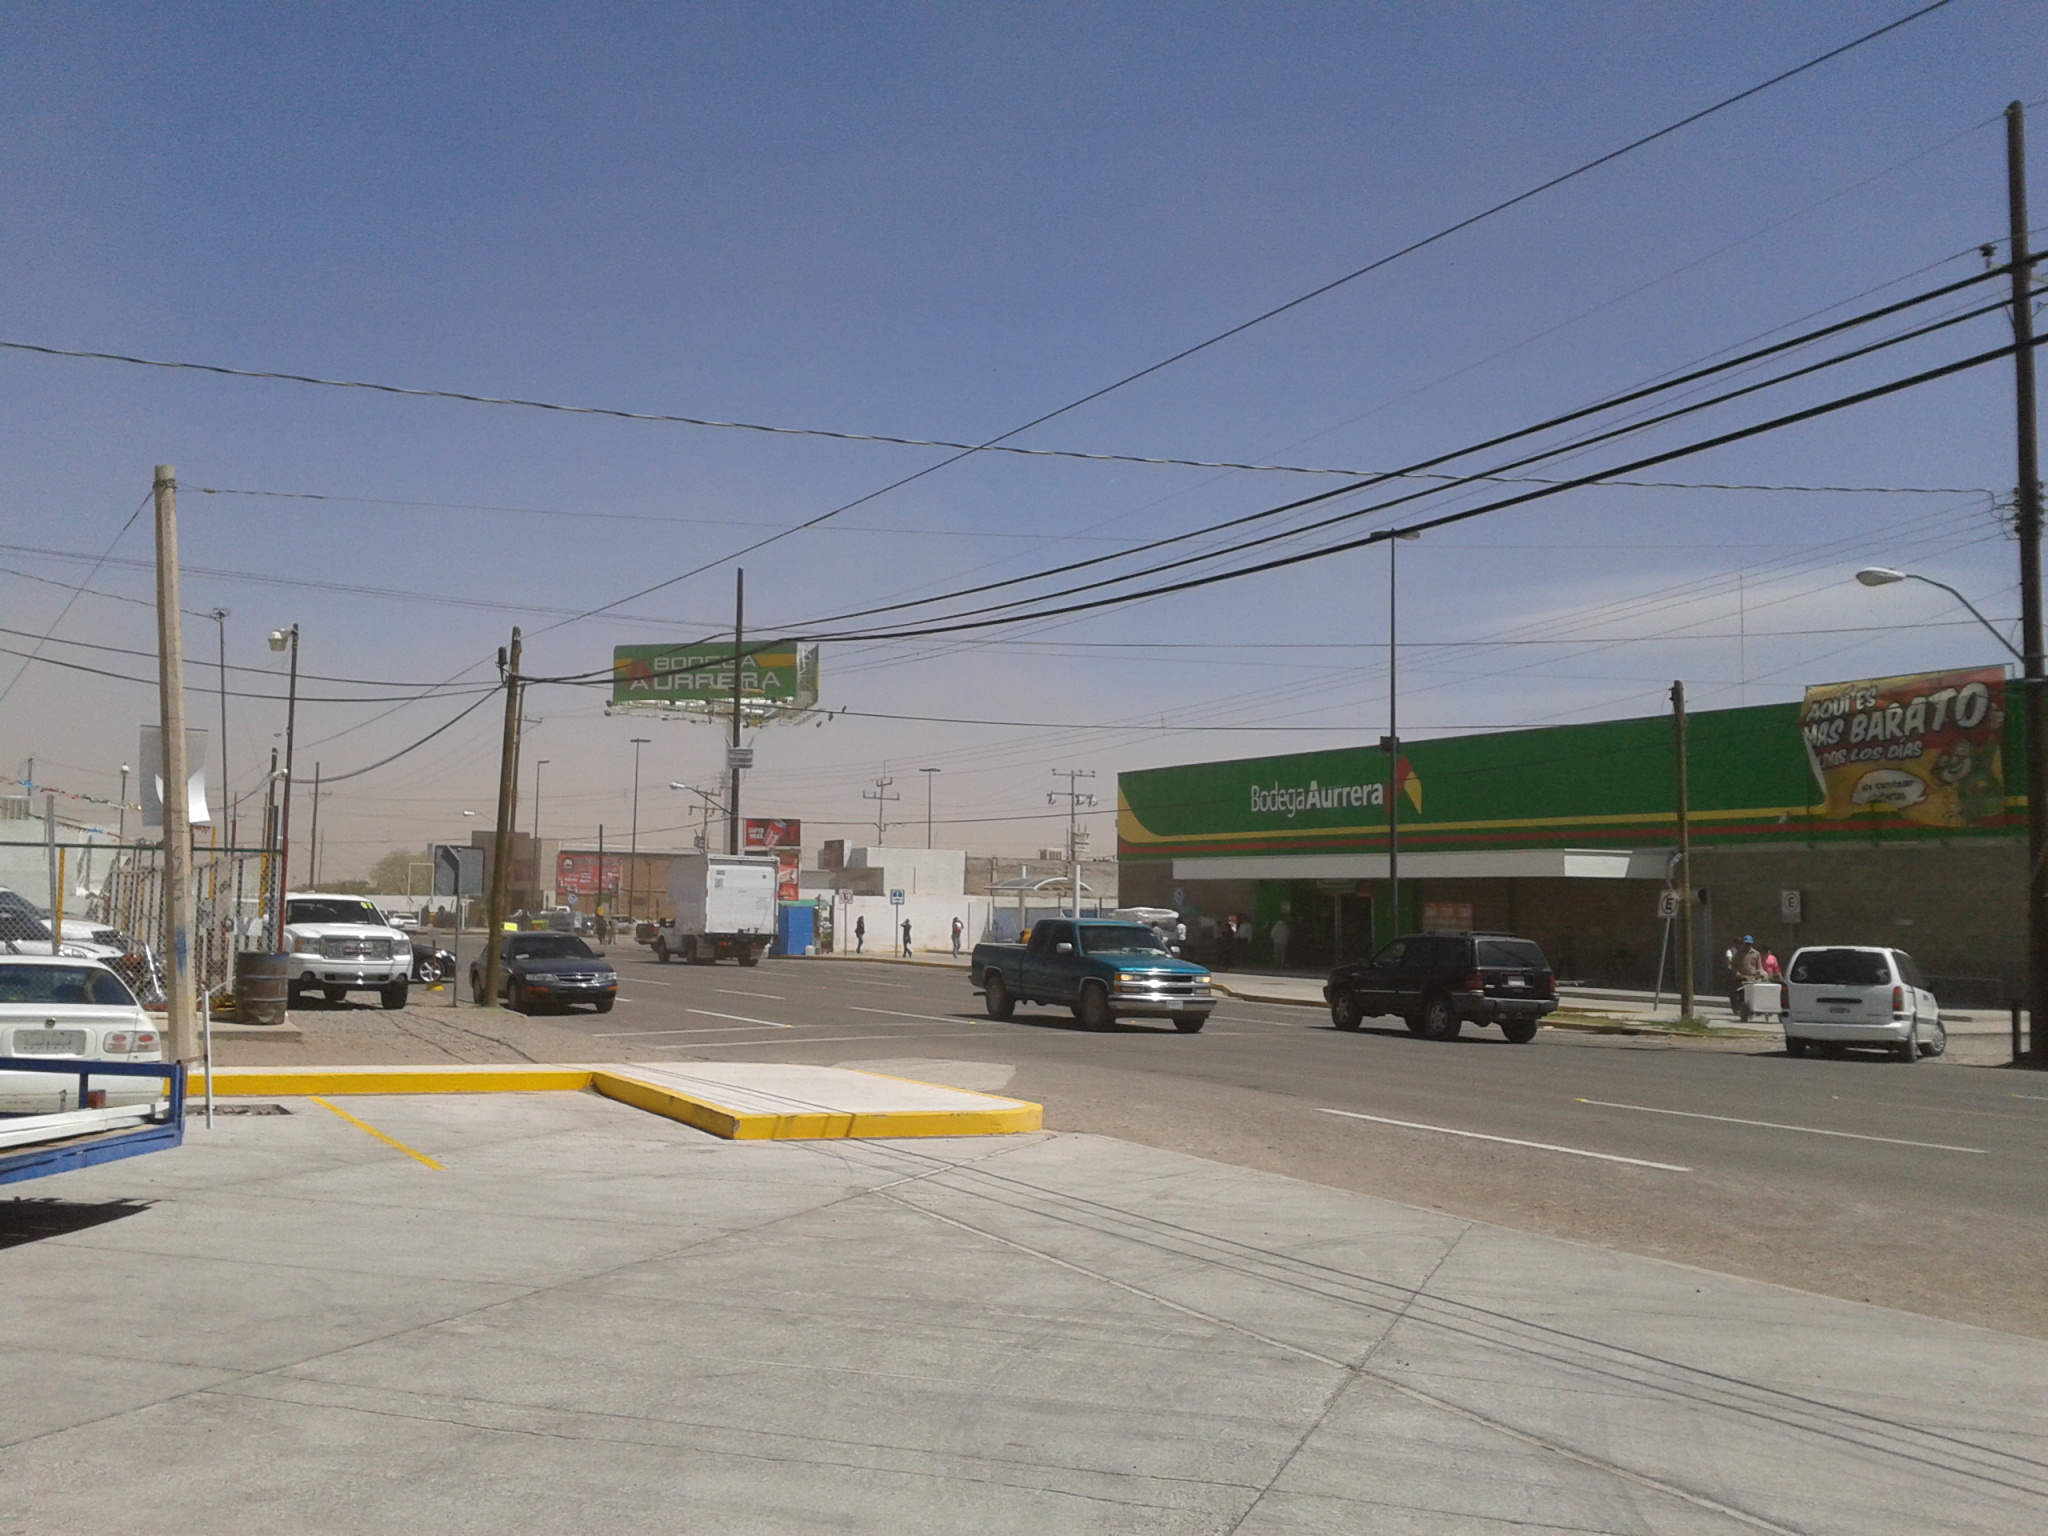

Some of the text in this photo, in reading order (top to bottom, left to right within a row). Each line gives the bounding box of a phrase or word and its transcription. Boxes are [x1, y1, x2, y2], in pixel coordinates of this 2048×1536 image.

[654, 655, 758, 671] BODEGA
[630, 672, 781, 691] AURRERA
[1855, 685, 1878, 709] ES
[1849, 682, 1990, 744] BARATO
[1850, 745, 1882, 761] LOS
[1886, 736, 1923, 759] DÍAS
[1251, 780, 1384, 818] Bodega Aurrera
[1665, 898, 1674, 910] E
[1788, 897, 1796, 908] E
